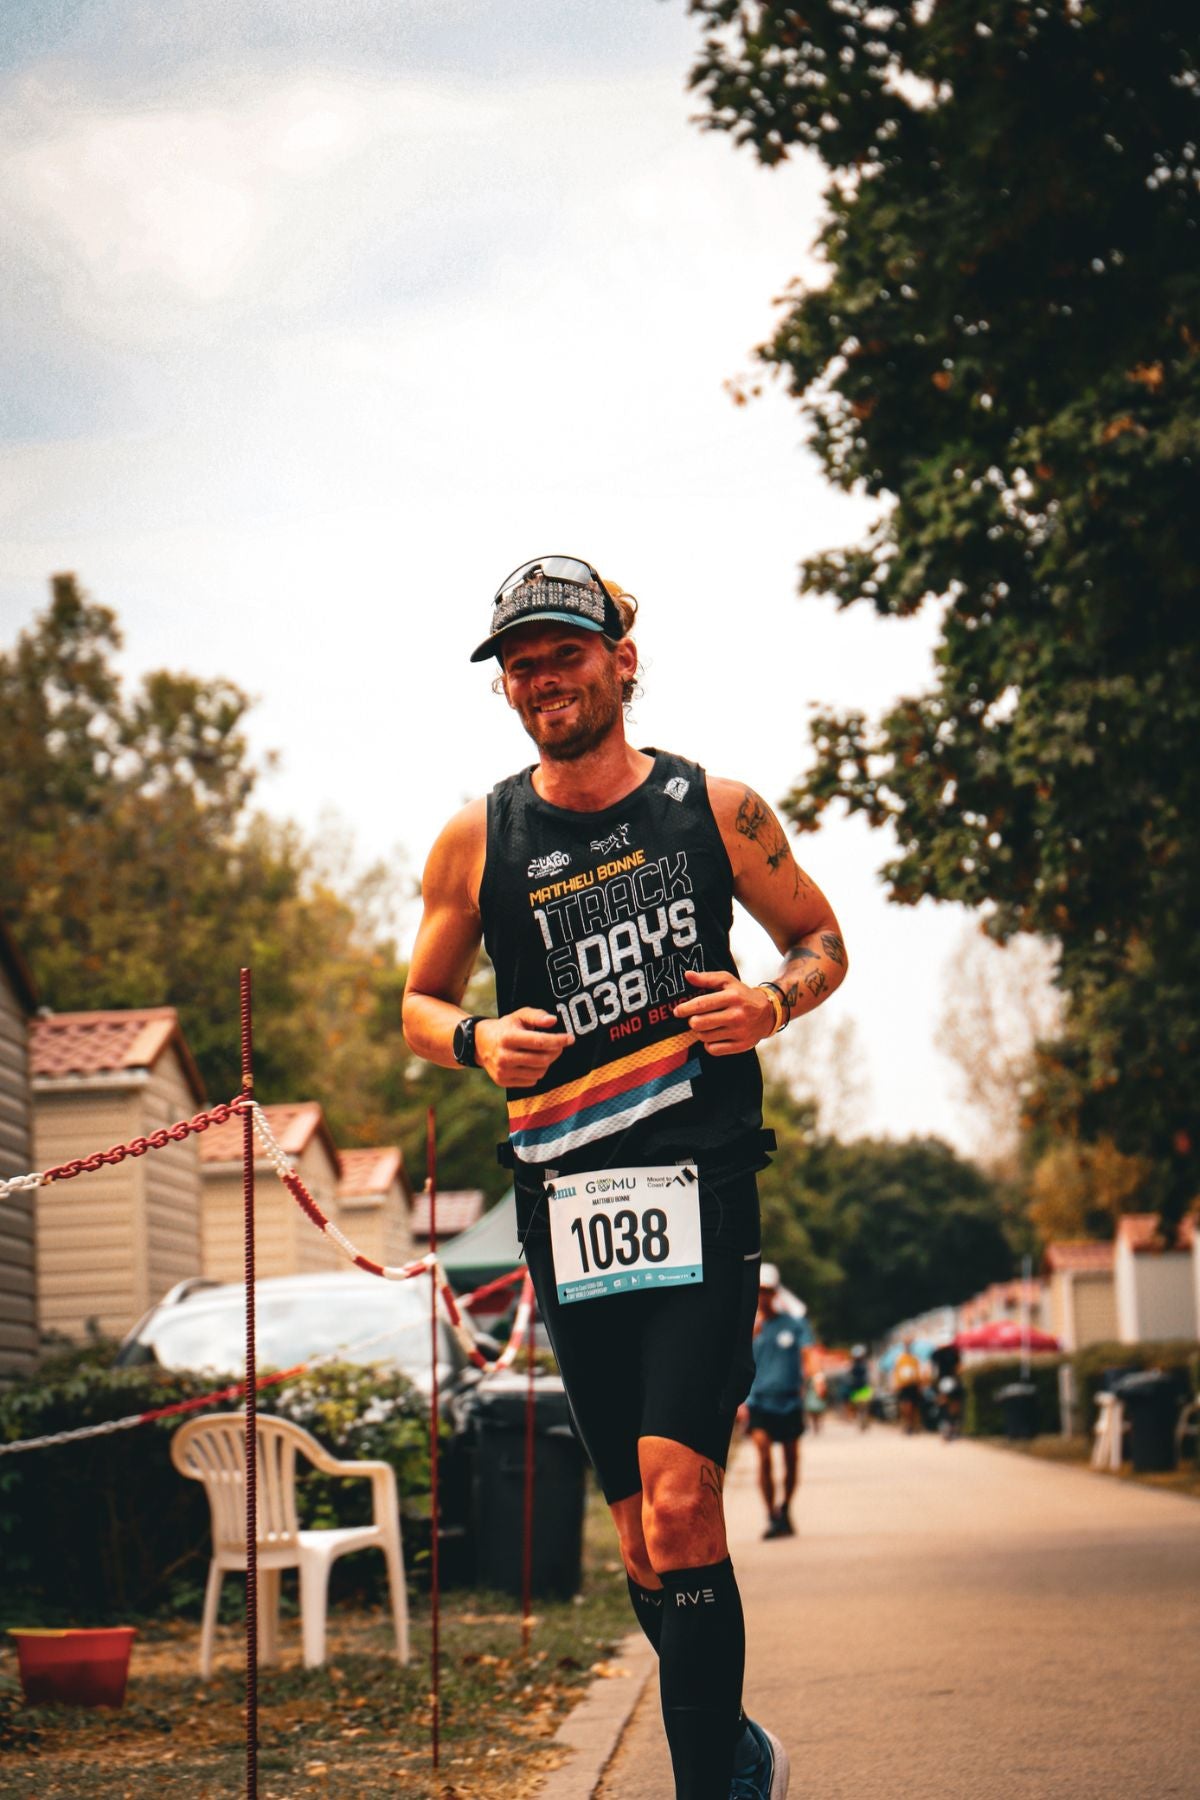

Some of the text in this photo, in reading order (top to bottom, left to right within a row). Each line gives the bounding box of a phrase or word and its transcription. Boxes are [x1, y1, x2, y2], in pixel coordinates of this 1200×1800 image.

[529, 849, 646, 907] MATTHIEU BONNE
[609, 1016, 642, 1042] AND
[585, 1177, 636, 1194] GOMU
[571, 1208, 670, 1273] 1038
[676, 1588, 715, 1607] RVE
